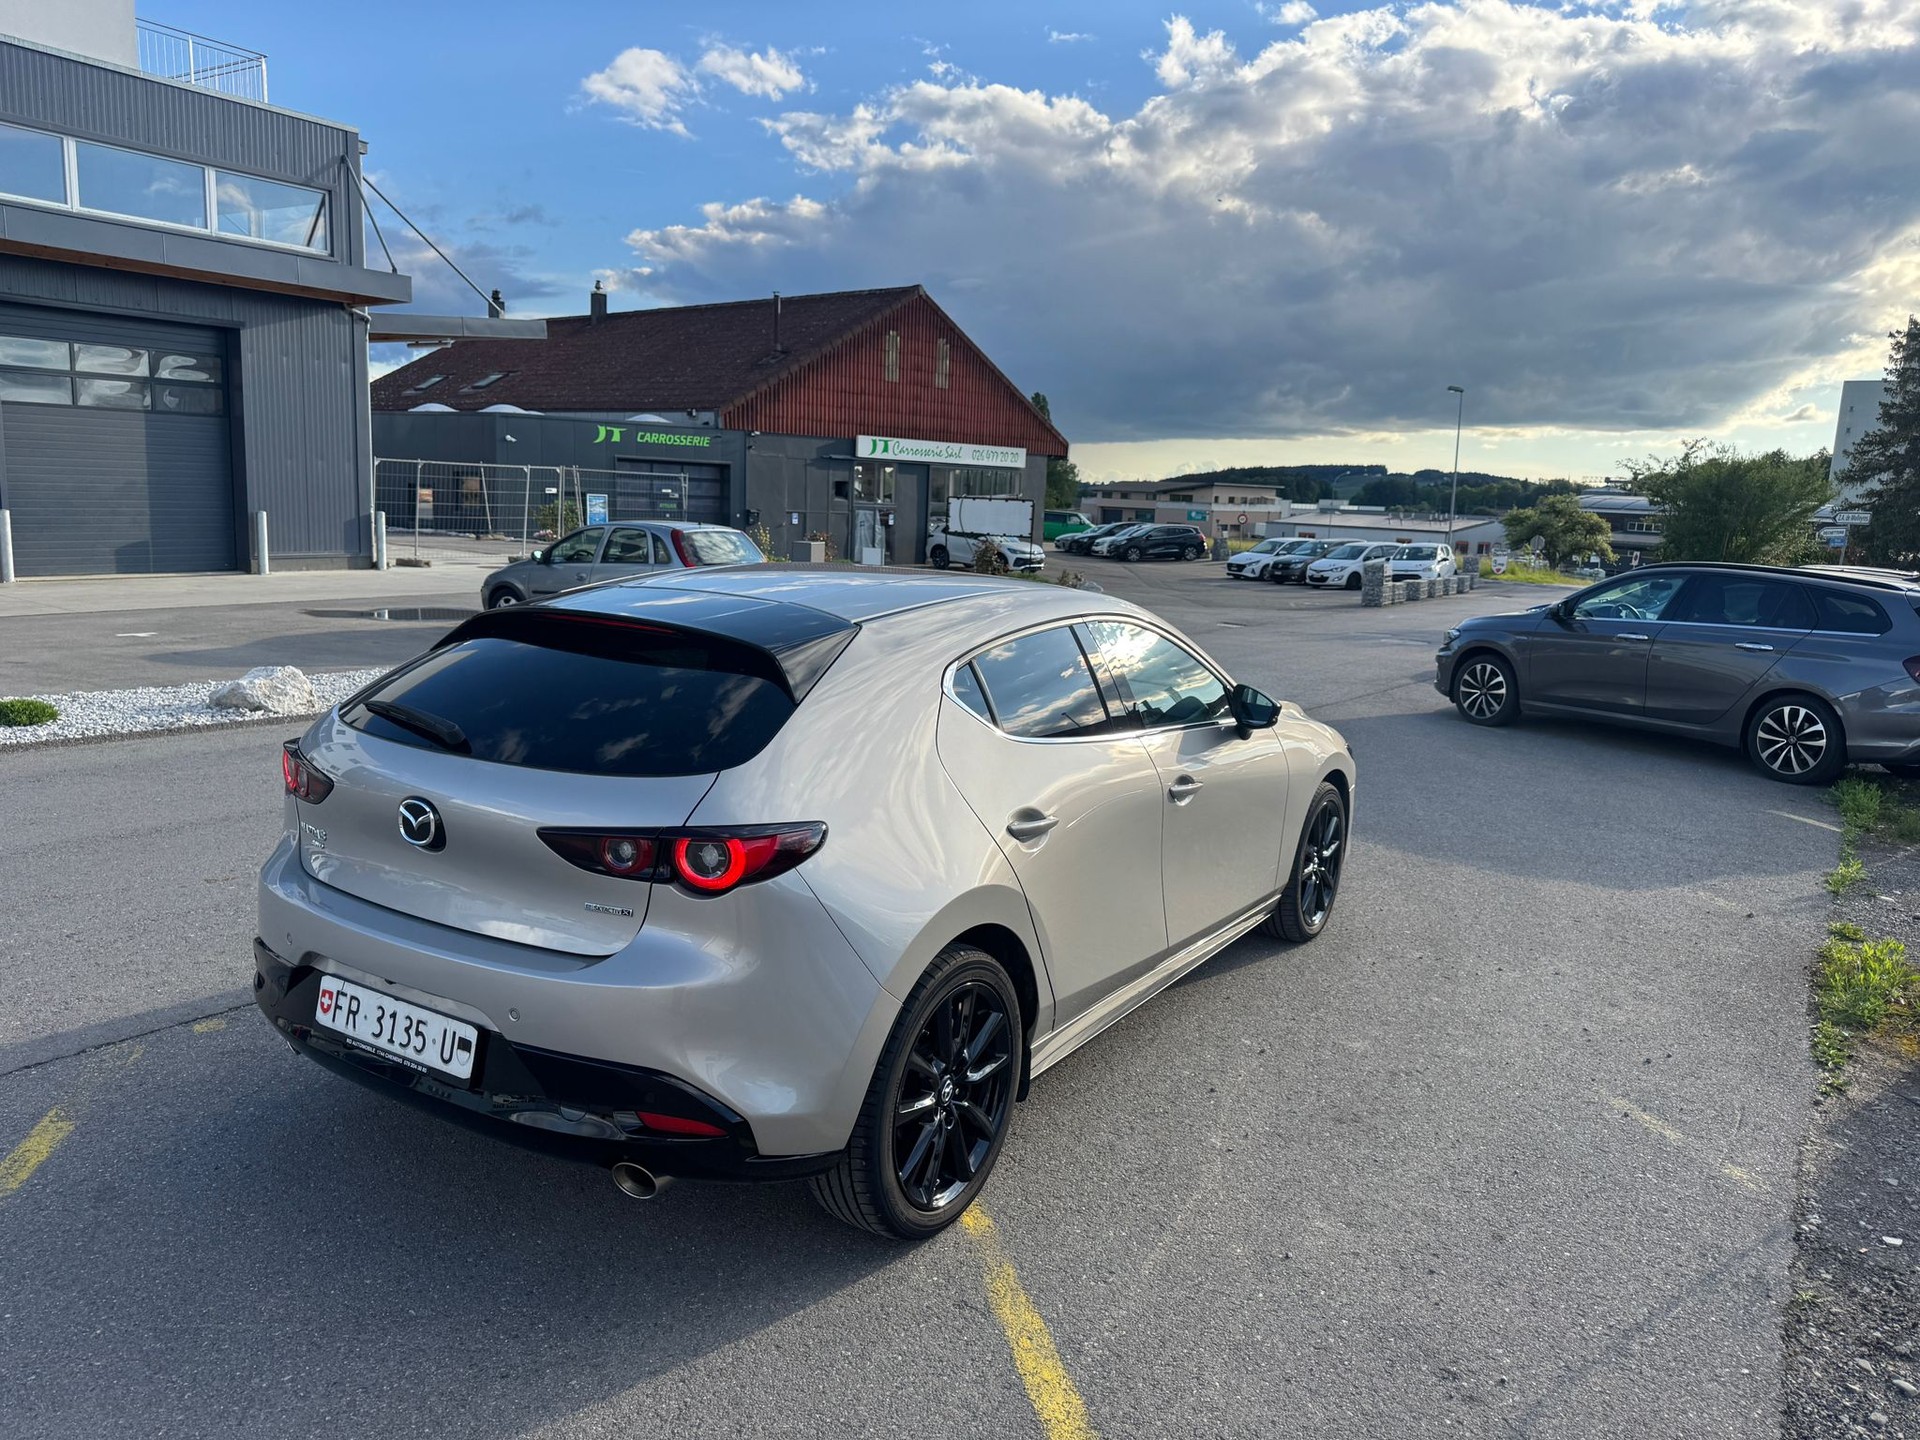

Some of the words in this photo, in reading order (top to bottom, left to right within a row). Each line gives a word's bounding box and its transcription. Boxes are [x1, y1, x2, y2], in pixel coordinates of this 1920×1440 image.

[593, 425, 627, 443] JT
[637, 431, 711, 447] CARROSSERIE
[868, 438, 893, 456] JT
[893, 440, 943, 458] Carrosserie
[972, 449, 984, 461] 026
[1000, 451, 1009, 463] 20
[1010, 452, 1019, 464] 20
[332, 990, 361, 1031] FR
[372, 1006, 428, 1054] 3135
[440, 1028, 457, 1065] U
